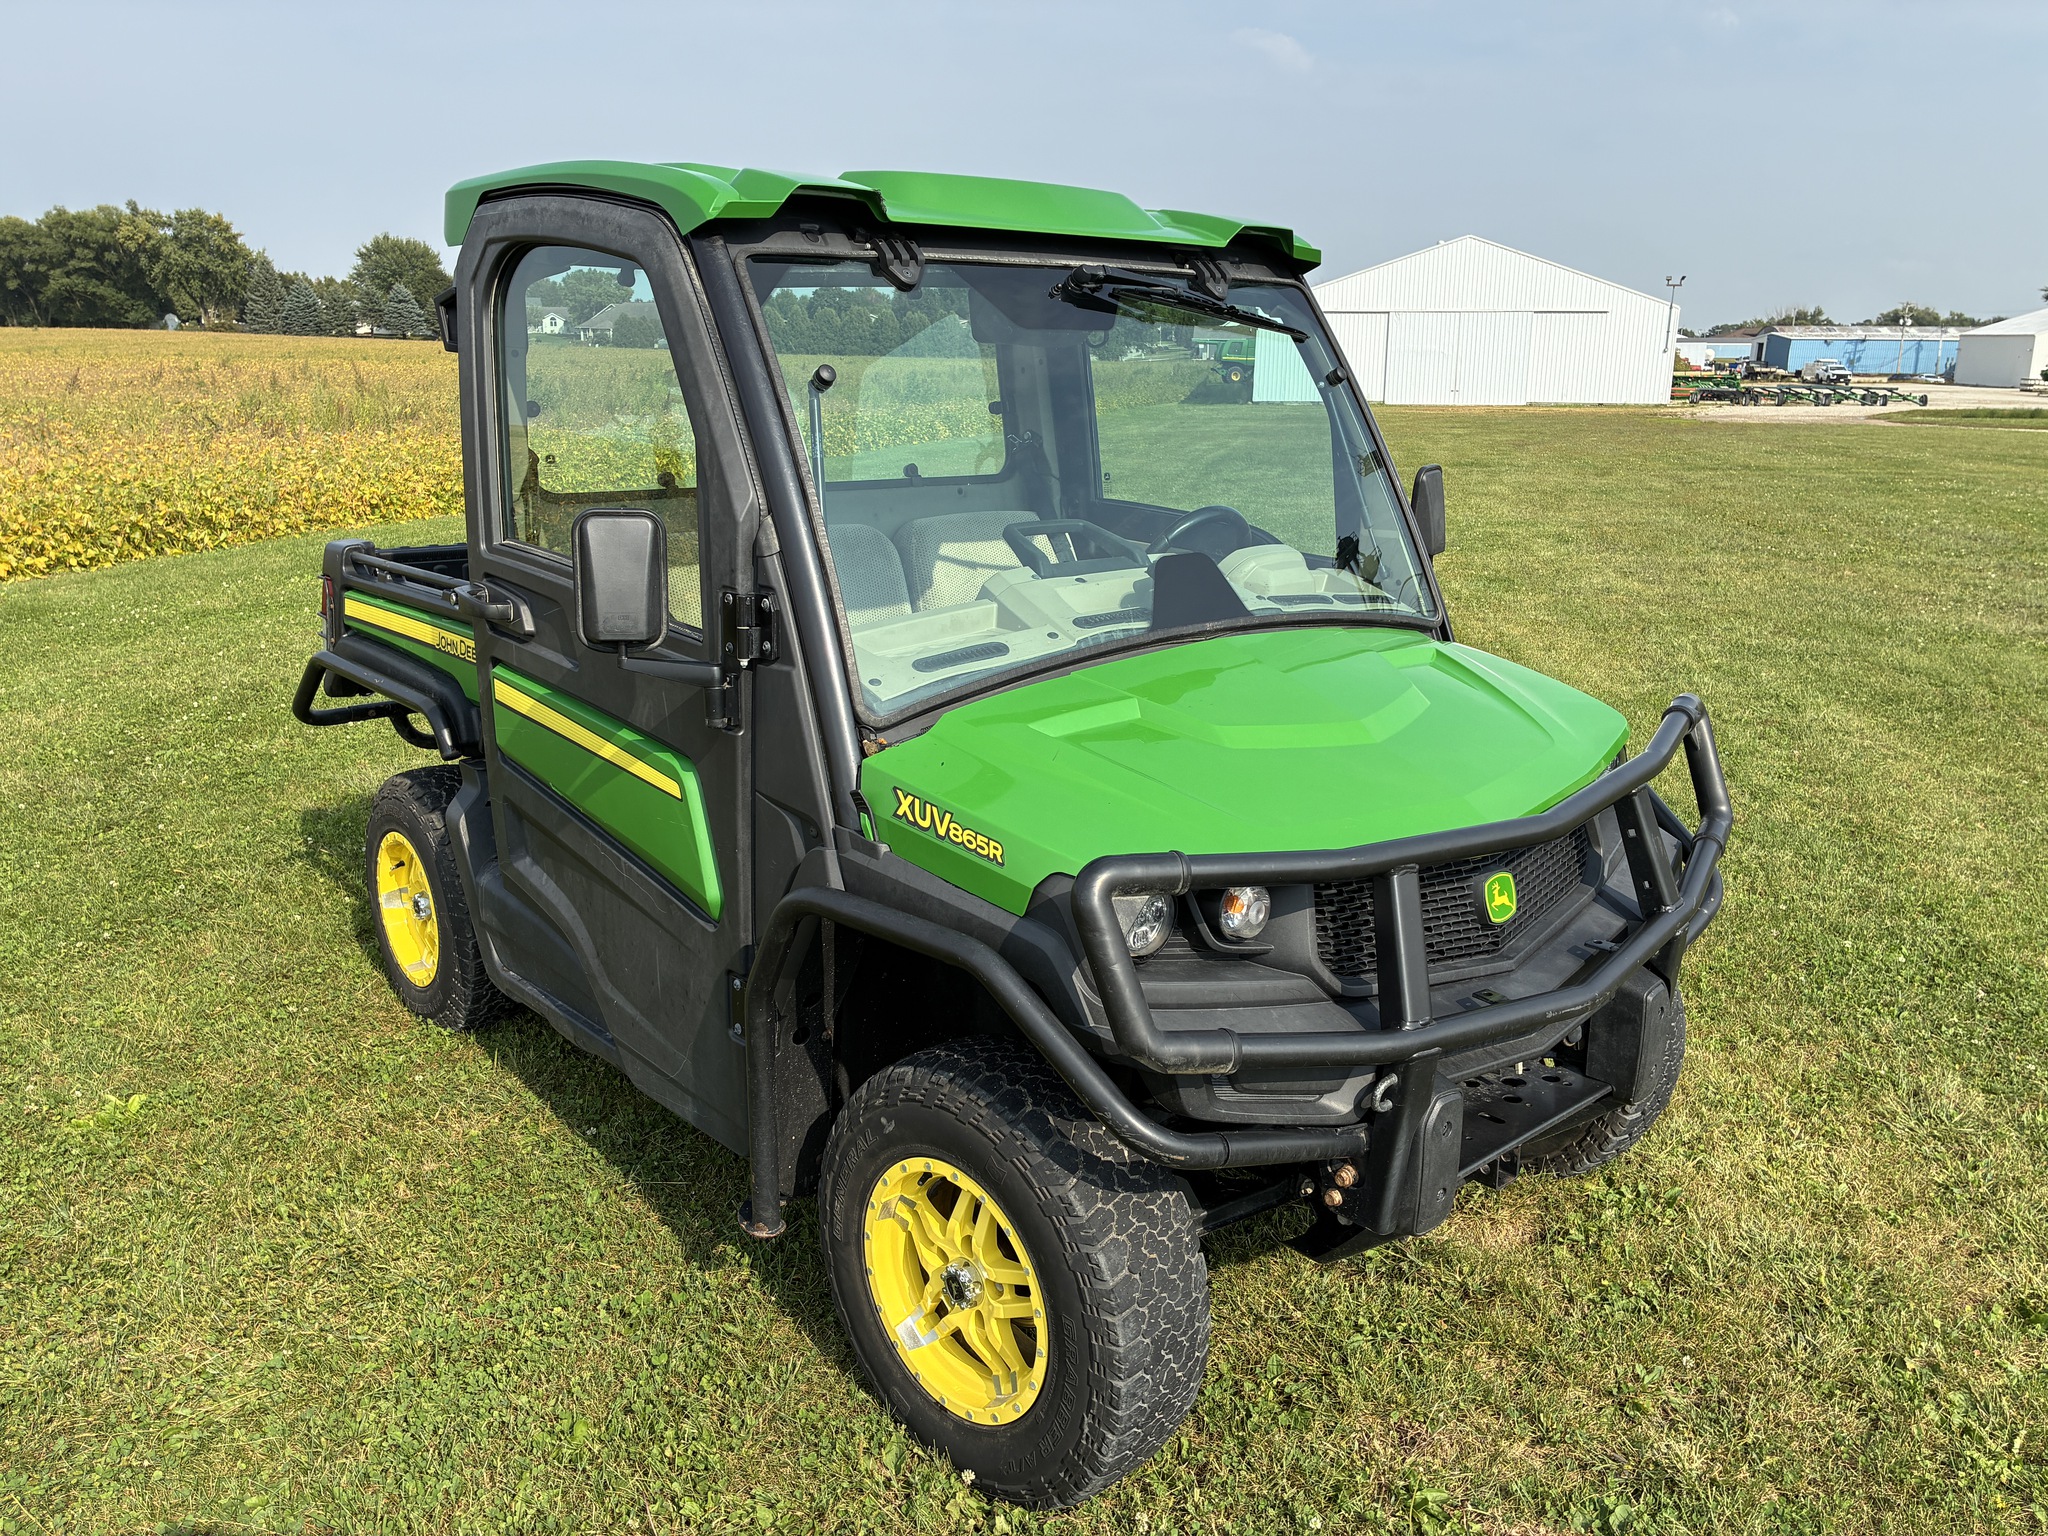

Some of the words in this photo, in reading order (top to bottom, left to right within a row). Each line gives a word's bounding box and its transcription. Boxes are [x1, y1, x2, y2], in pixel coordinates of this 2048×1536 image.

[436, 631, 458, 655] JOHN
[459, 639, 477, 661] DEE
[893, 786, 1005, 866] XUV865R
[833, 1128, 879, 1241] GENERAL
[1038, 1314, 1079, 1458] GRABBER
